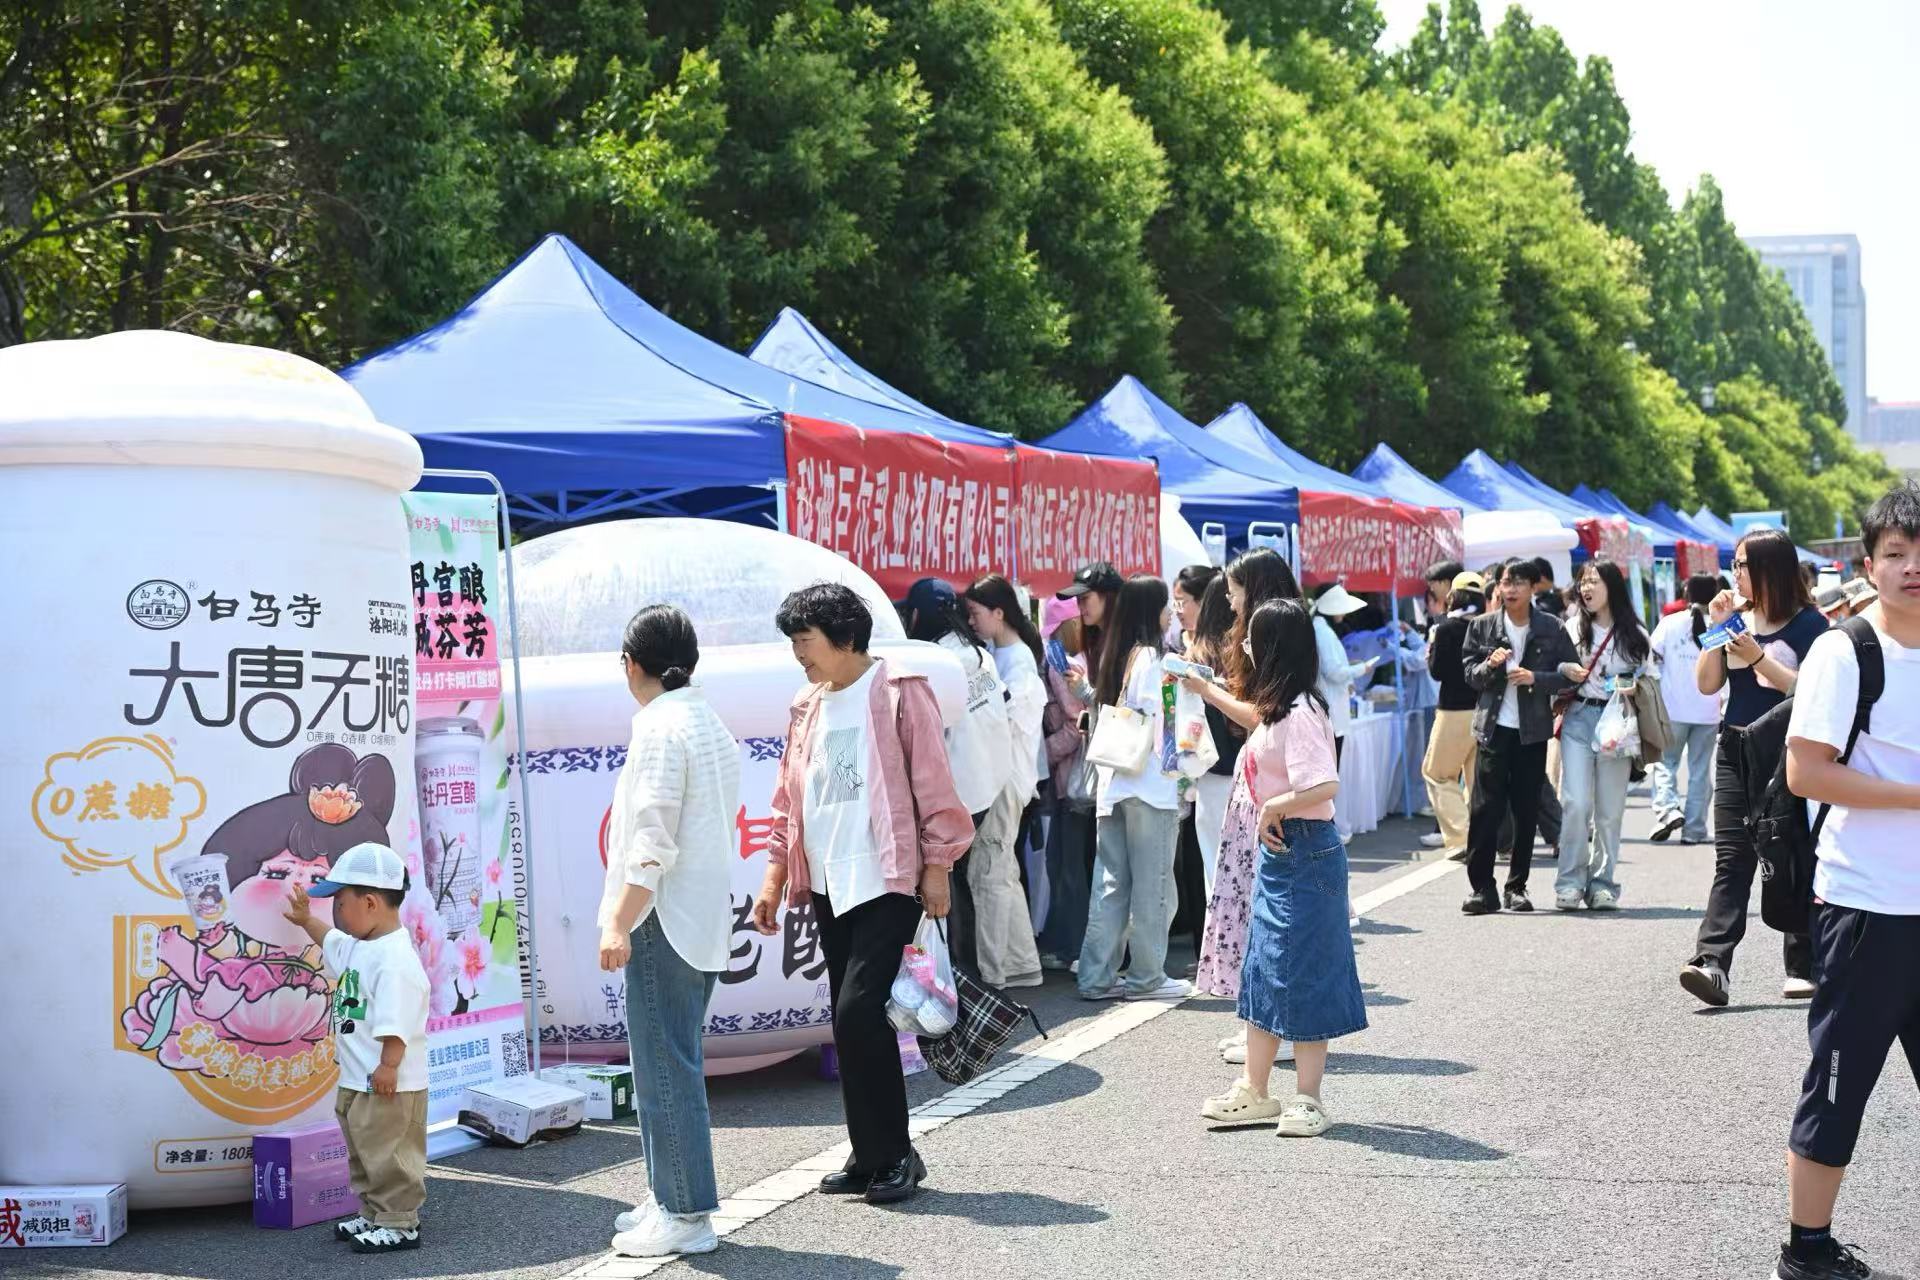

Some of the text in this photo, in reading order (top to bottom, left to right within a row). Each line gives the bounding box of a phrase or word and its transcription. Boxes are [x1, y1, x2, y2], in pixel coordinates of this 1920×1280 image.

[197, 590, 323, 629] 白马寺
[124, 641, 410, 748] 大唐无糖
[49, 782, 175, 824] 0蔗糖
[22, 1217, 71, 1233] 减负担
